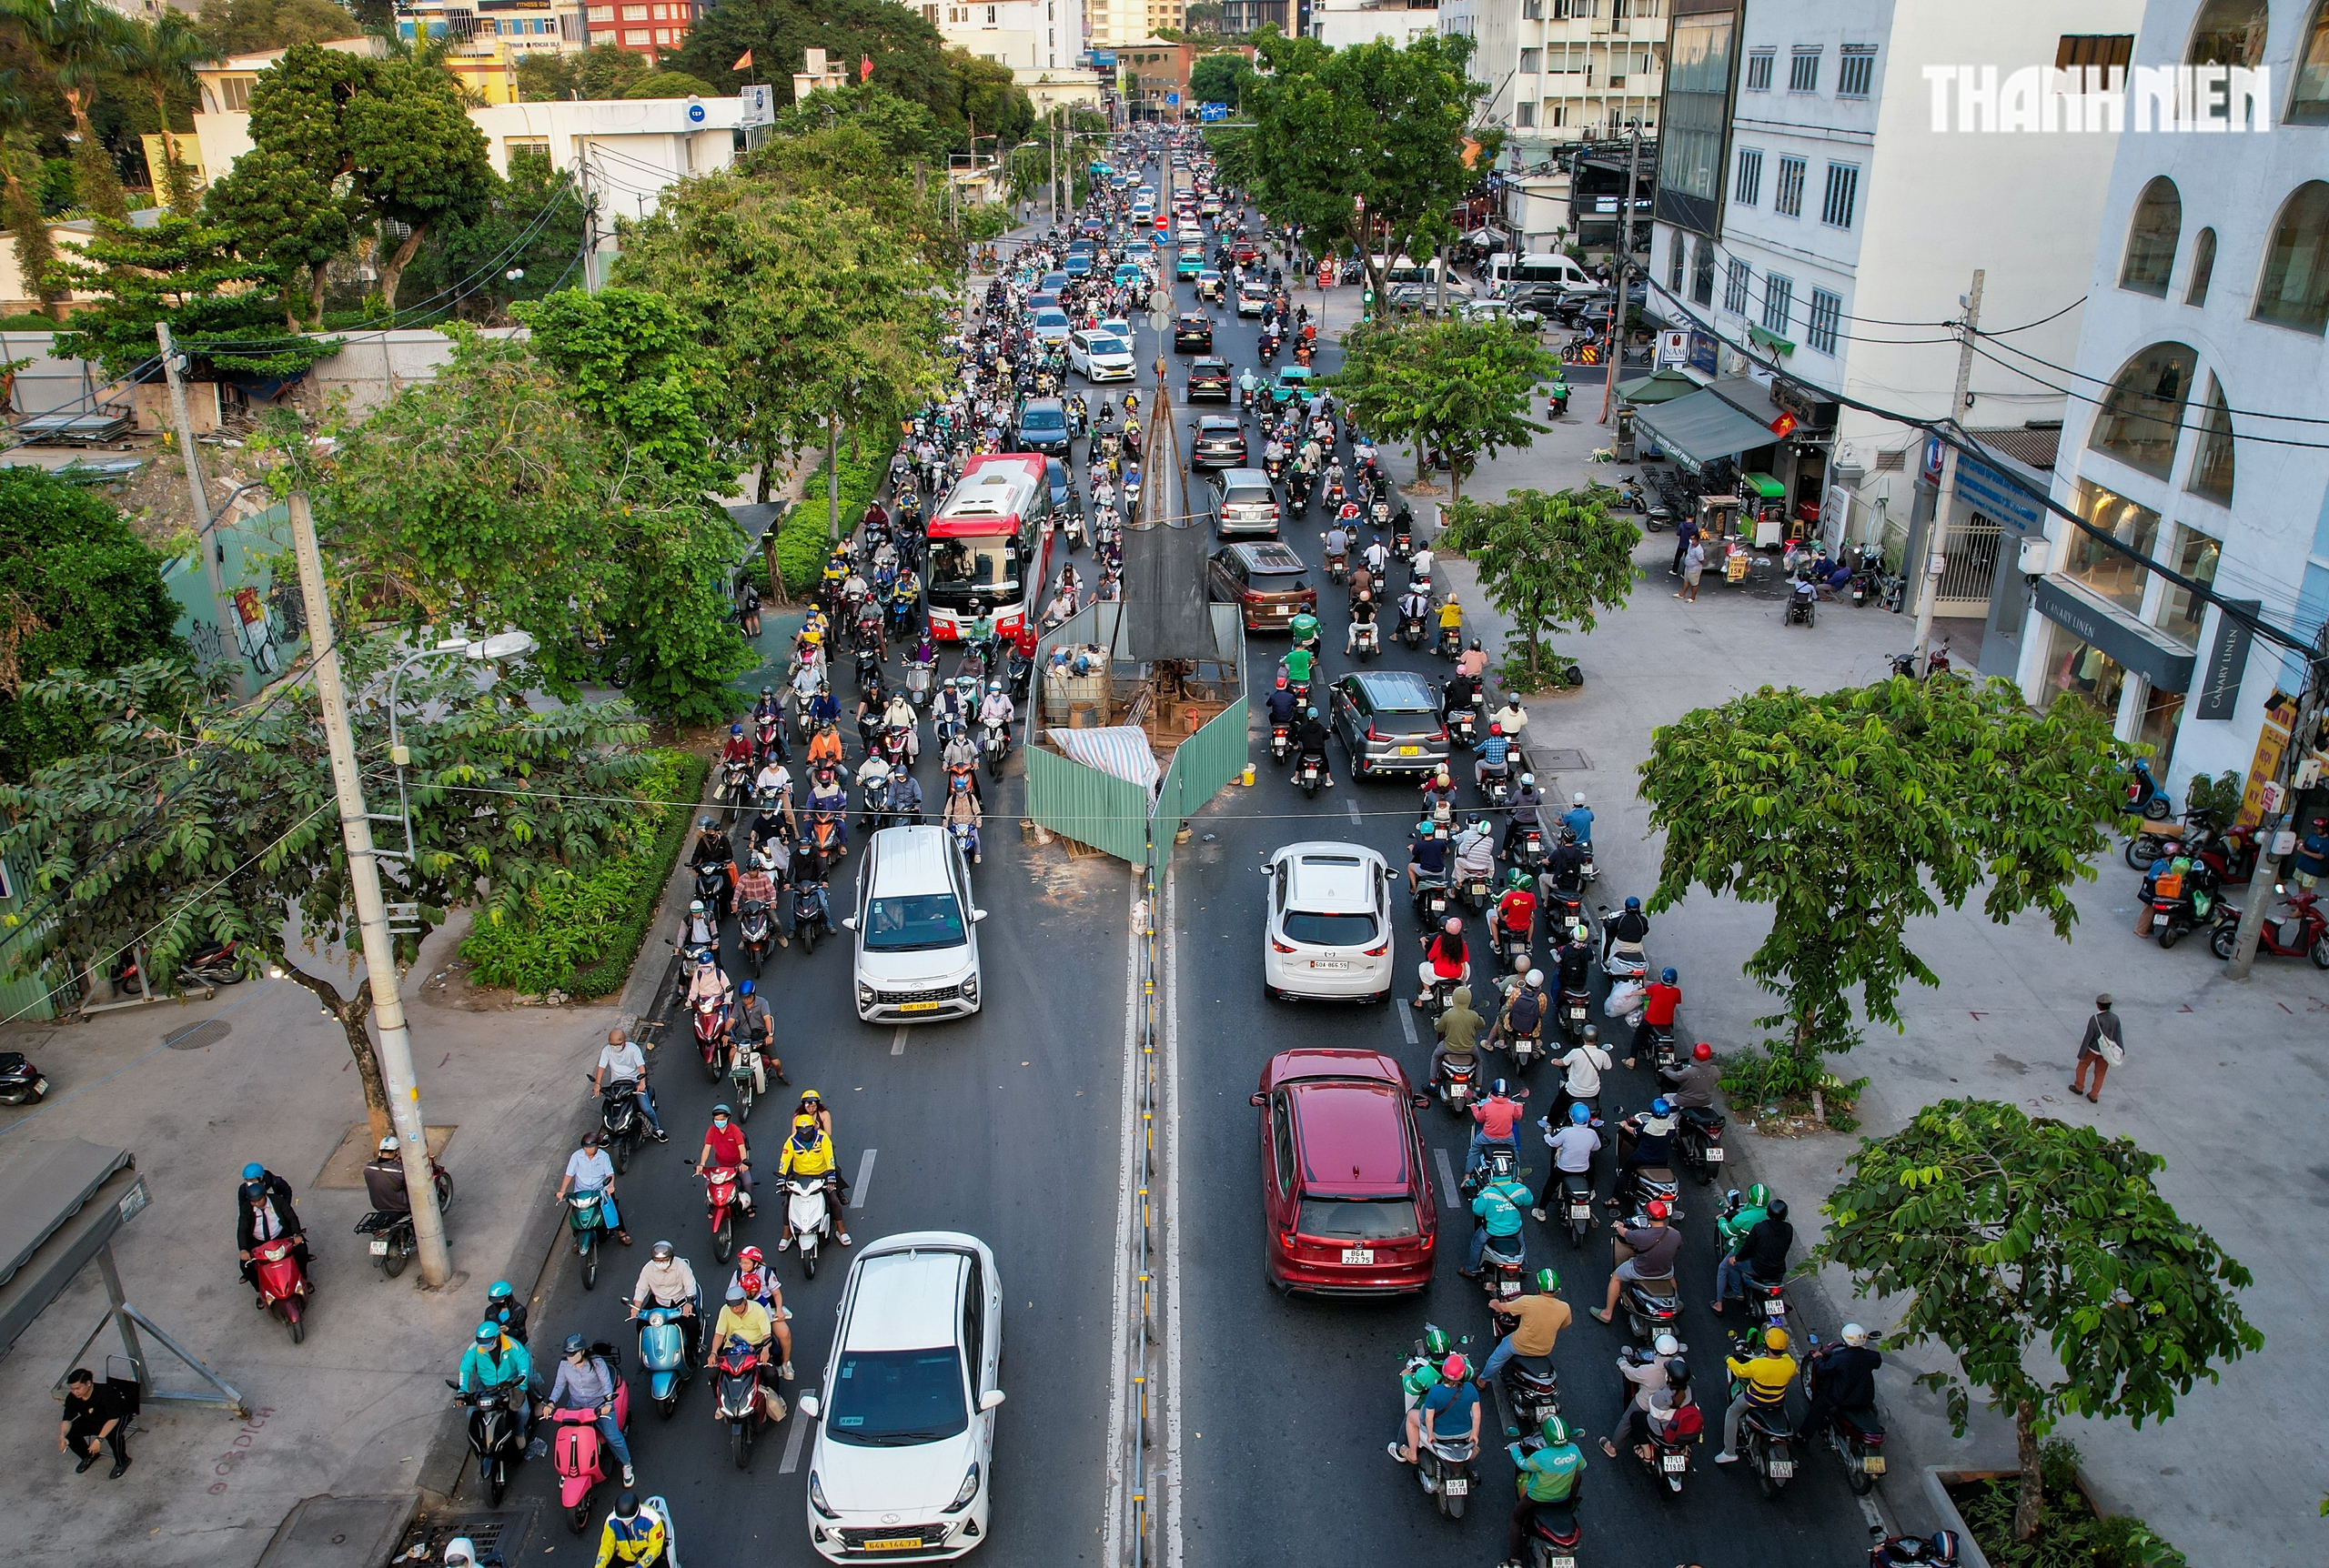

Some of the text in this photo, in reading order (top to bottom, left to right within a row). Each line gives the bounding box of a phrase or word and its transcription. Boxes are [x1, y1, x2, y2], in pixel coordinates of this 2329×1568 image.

[1347, 509, 1353, 518] 5
[2045, 599, 2095, 638] CANARY LINEN
[2211, 628, 2239, 709] CANARY LINEN
[1553, 1453, 1577, 1466] Grab
